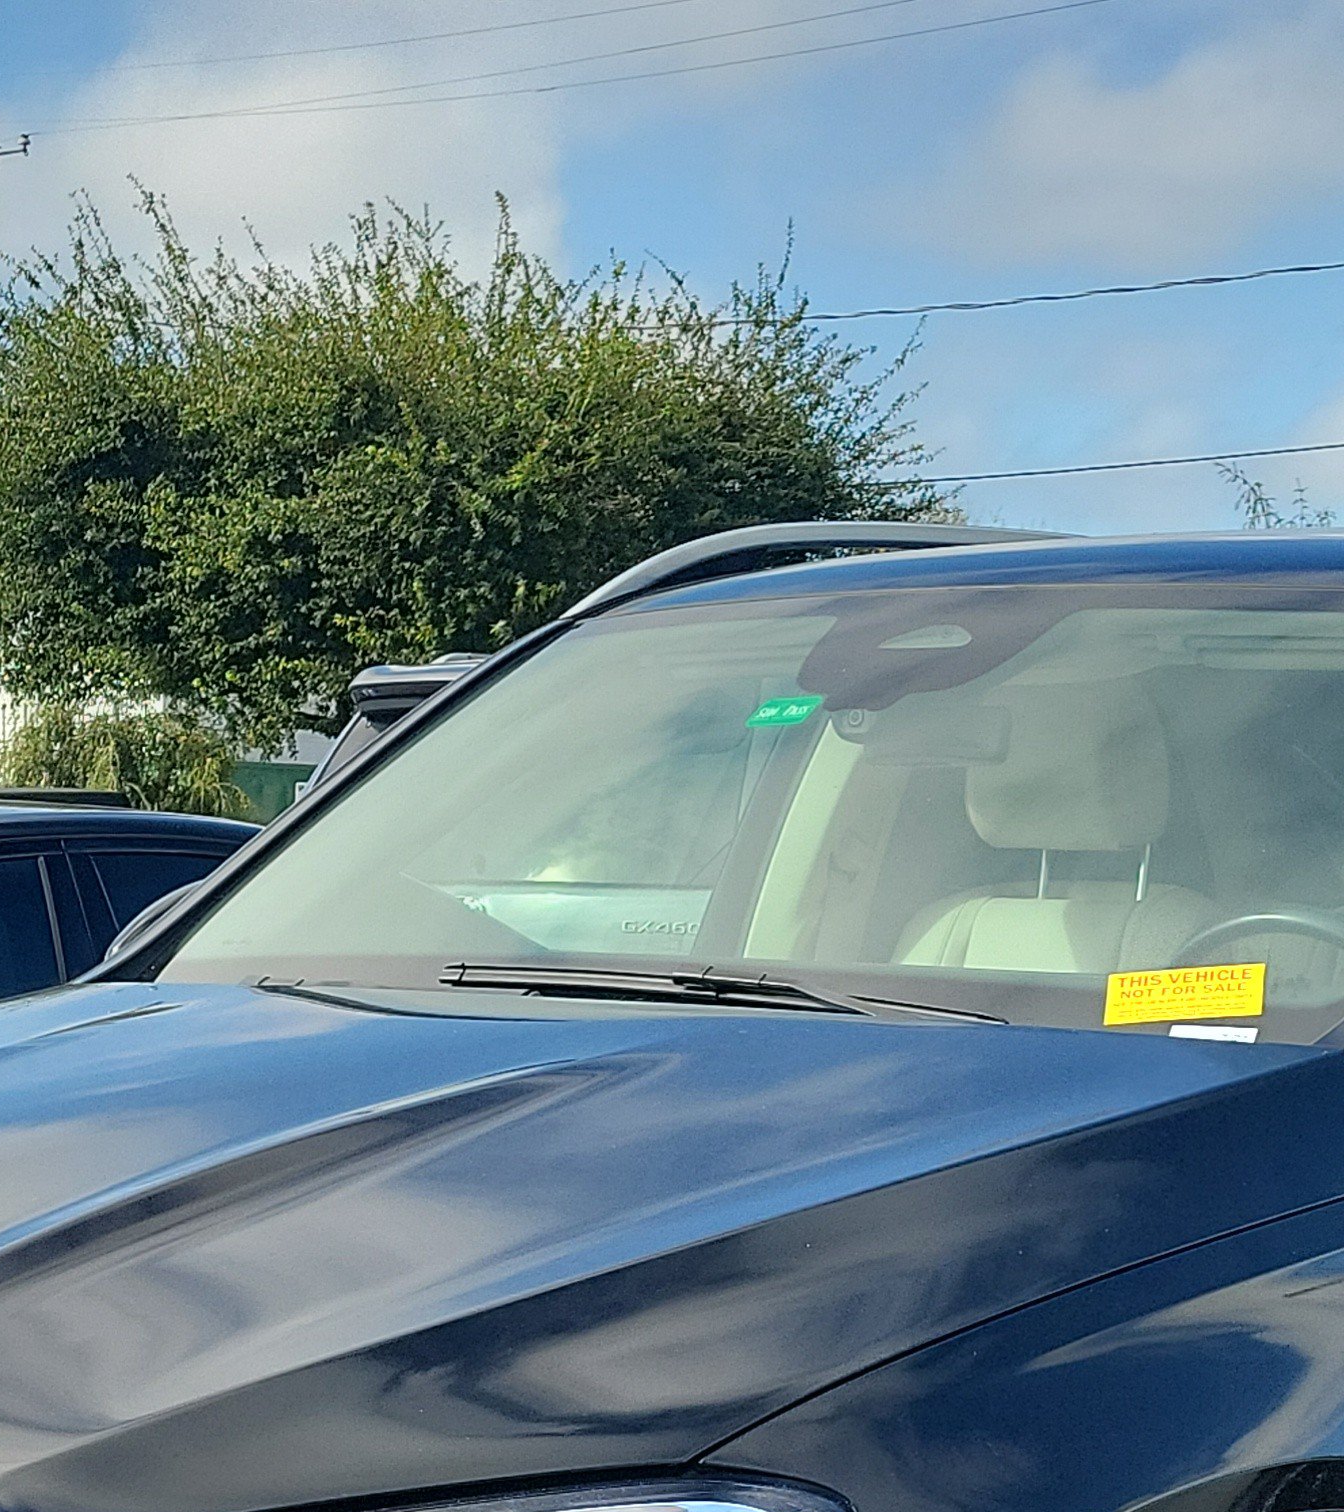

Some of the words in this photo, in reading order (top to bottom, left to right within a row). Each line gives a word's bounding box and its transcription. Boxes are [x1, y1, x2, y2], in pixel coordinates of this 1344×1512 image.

[621, 920, 701, 935] GX460
[1118, 975, 1162, 988] THIS
[1169, 968, 1253, 984] VEHICLE
[1120, 988, 1154, 999] NOT
[1162, 986, 1196, 995] FOR
[1203, 982, 1247, 994] SALE
